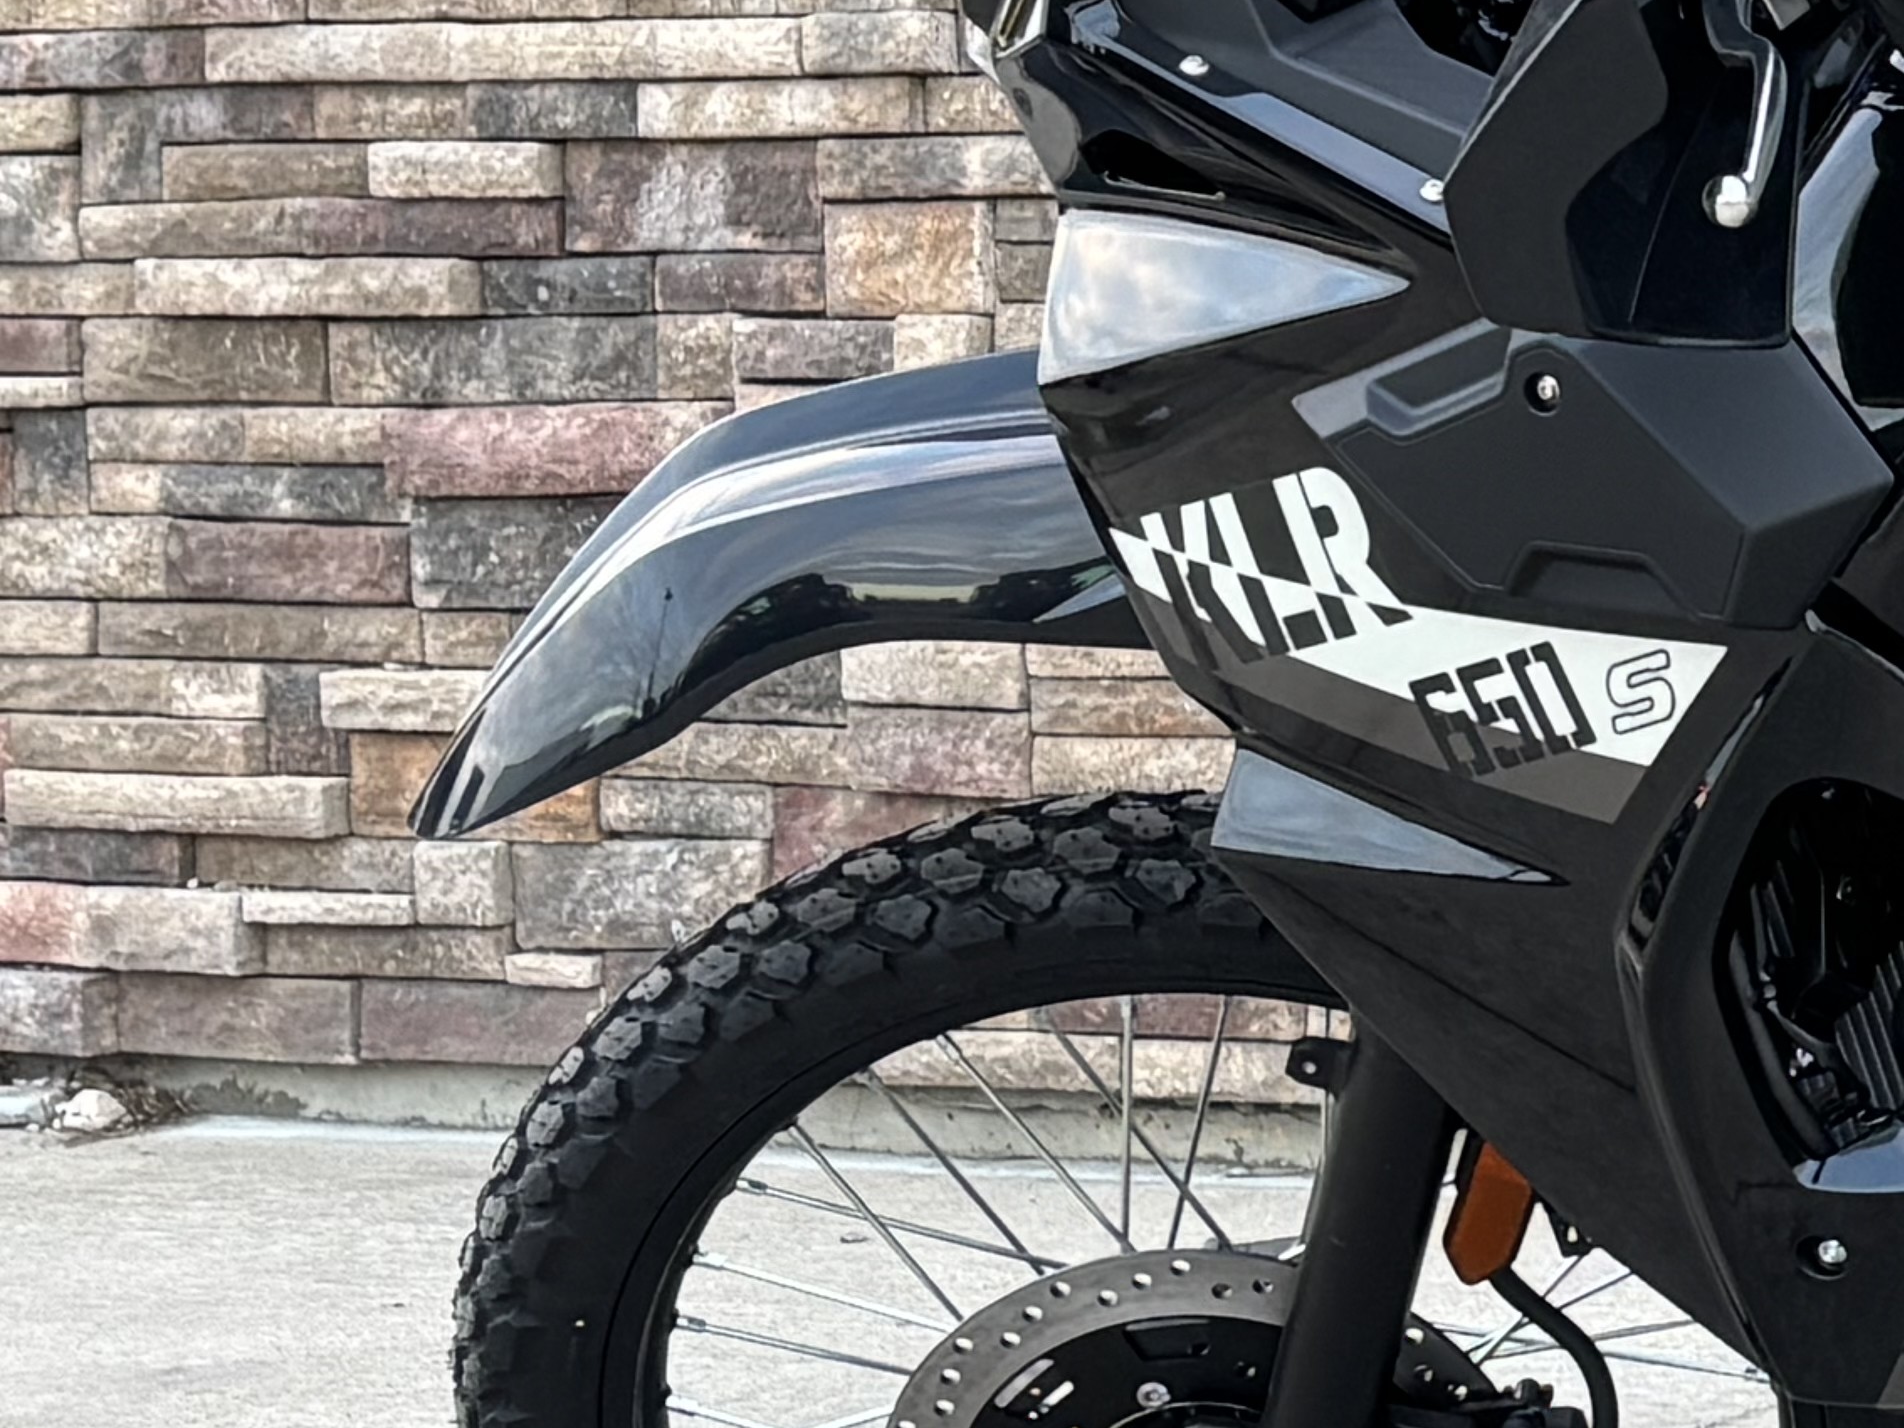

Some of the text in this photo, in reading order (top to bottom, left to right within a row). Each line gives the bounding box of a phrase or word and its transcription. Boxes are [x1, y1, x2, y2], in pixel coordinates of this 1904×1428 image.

[1139, 466, 1414, 671] KLR
[1408, 640, 1676, 778] 650 S
